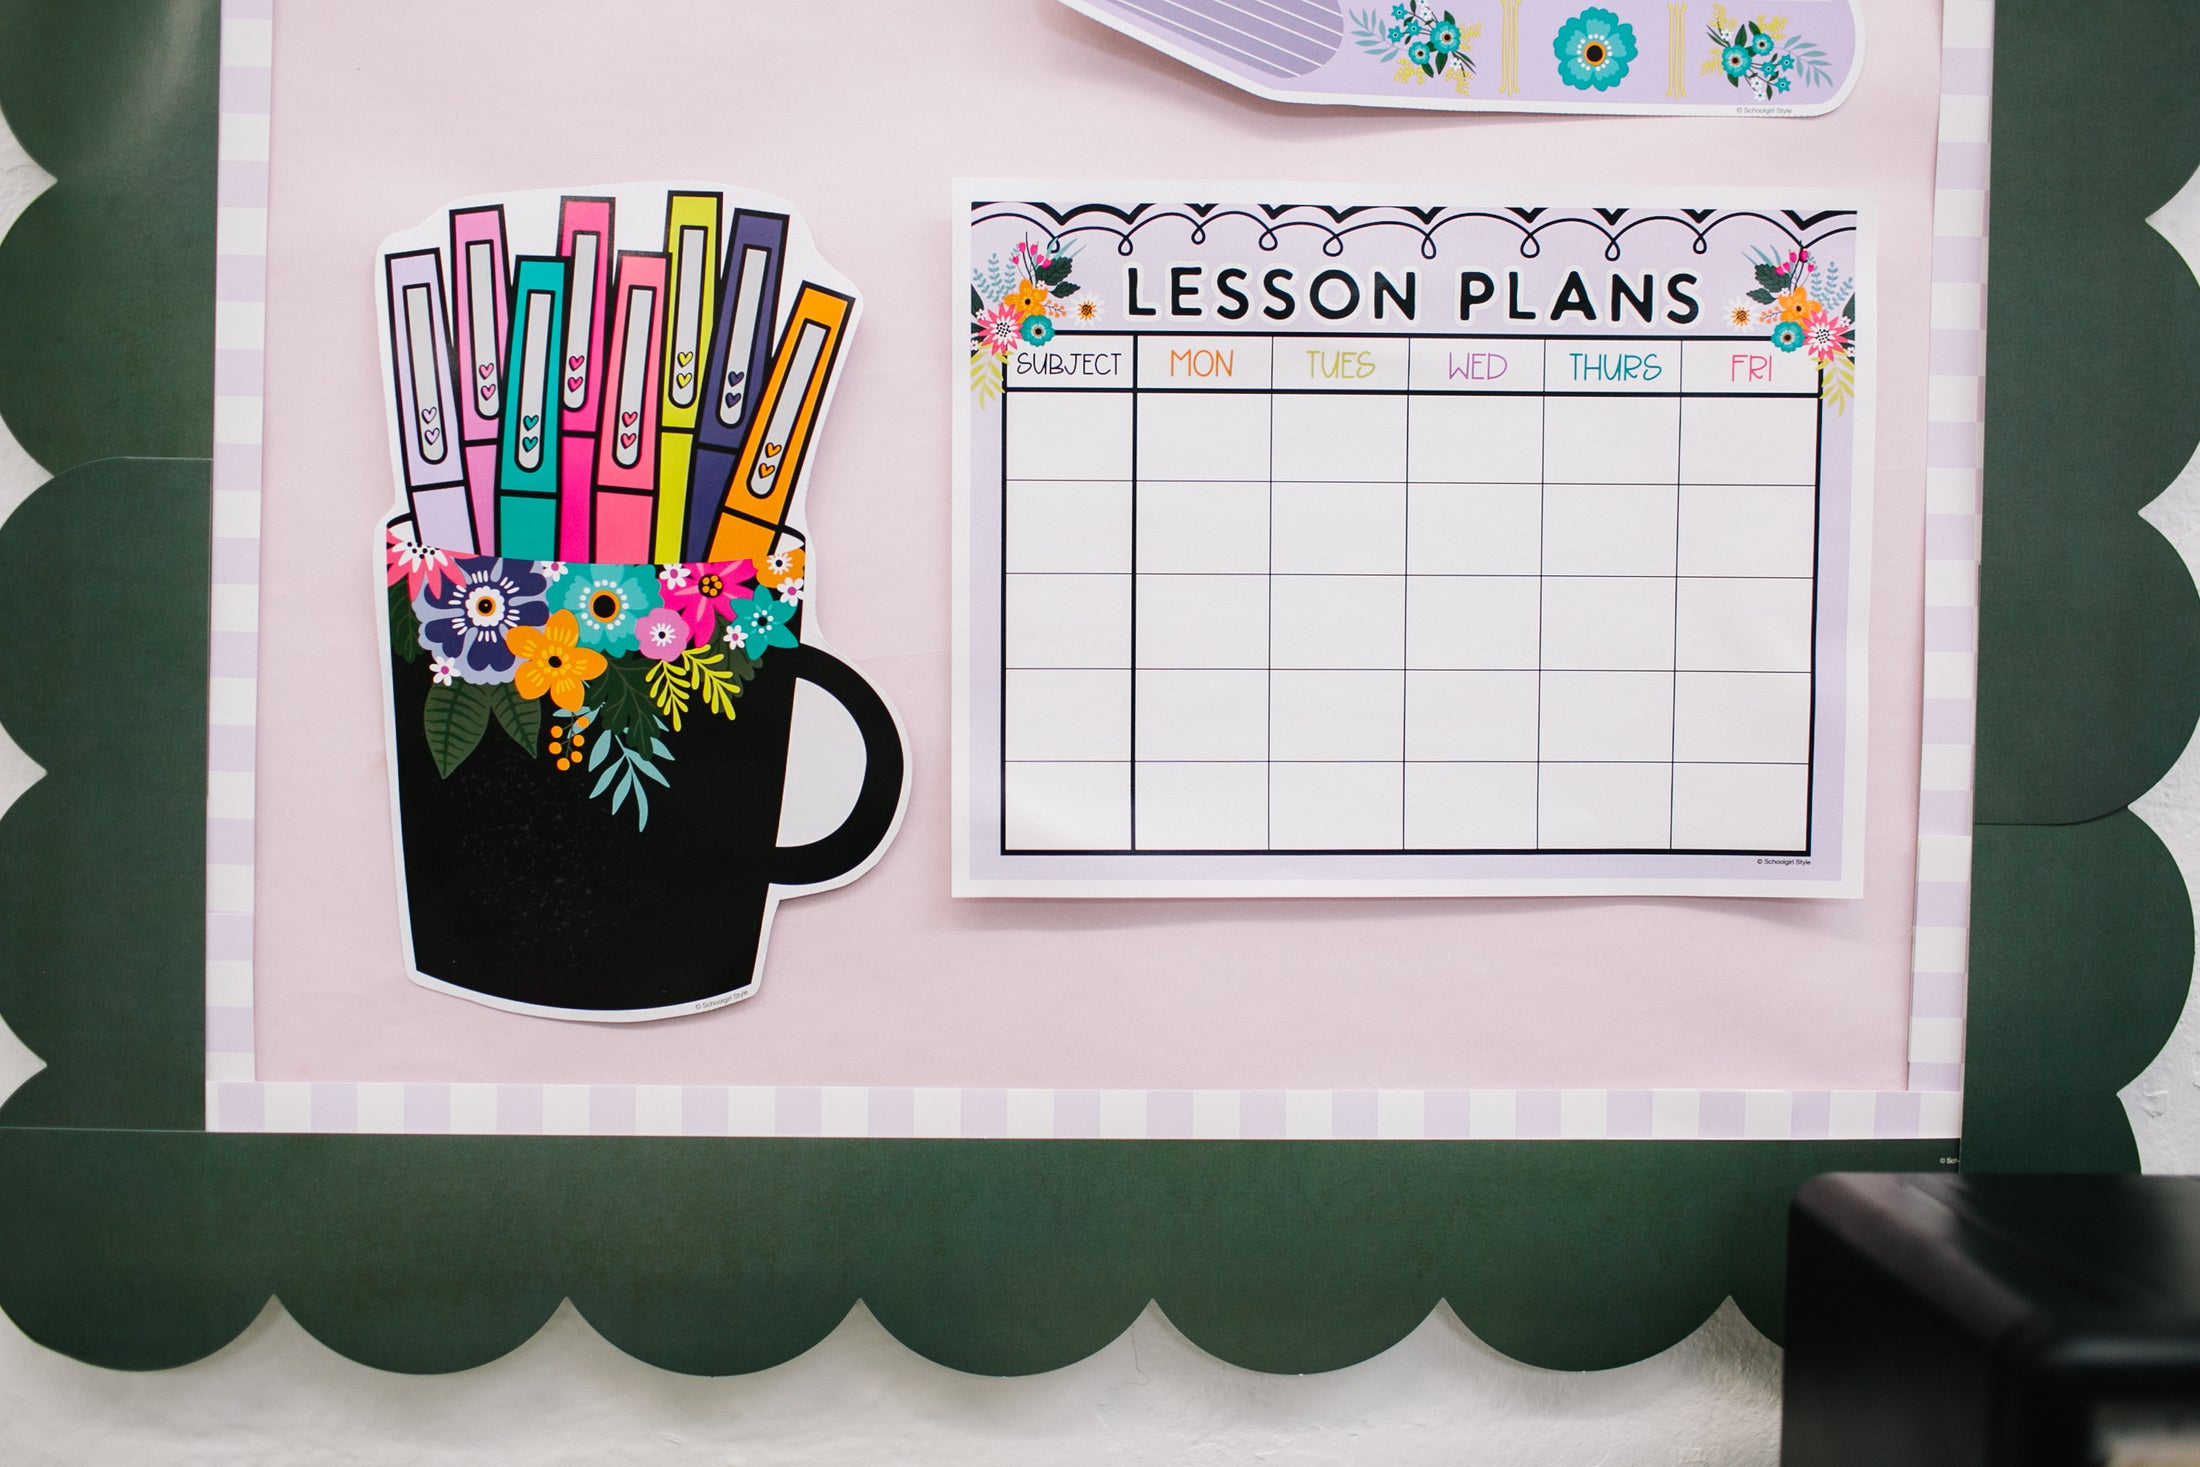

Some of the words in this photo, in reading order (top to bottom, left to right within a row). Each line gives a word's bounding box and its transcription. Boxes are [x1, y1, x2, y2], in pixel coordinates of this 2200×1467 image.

[1744, 107, 1775, 115] Schoolgirl
[1776, 107, 1792, 115] Style
[1127, 266, 1416, 322] LESSON
[1460, 270, 1699, 325] PLANS
[1017, 350, 1123, 377] SUBJECT
[1170, 348, 1234, 379] MON
[1307, 350, 1376, 379] TUES
[1447, 352, 1509, 382] WED
[1569, 351, 1663, 382] THURS
[1731, 354, 1773, 382] FRI
[1764, 858, 1794, 866] Schoolgirl
[703, 995, 733, 1009] Schoolgirl
[733, 990, 748, 1000] Style
